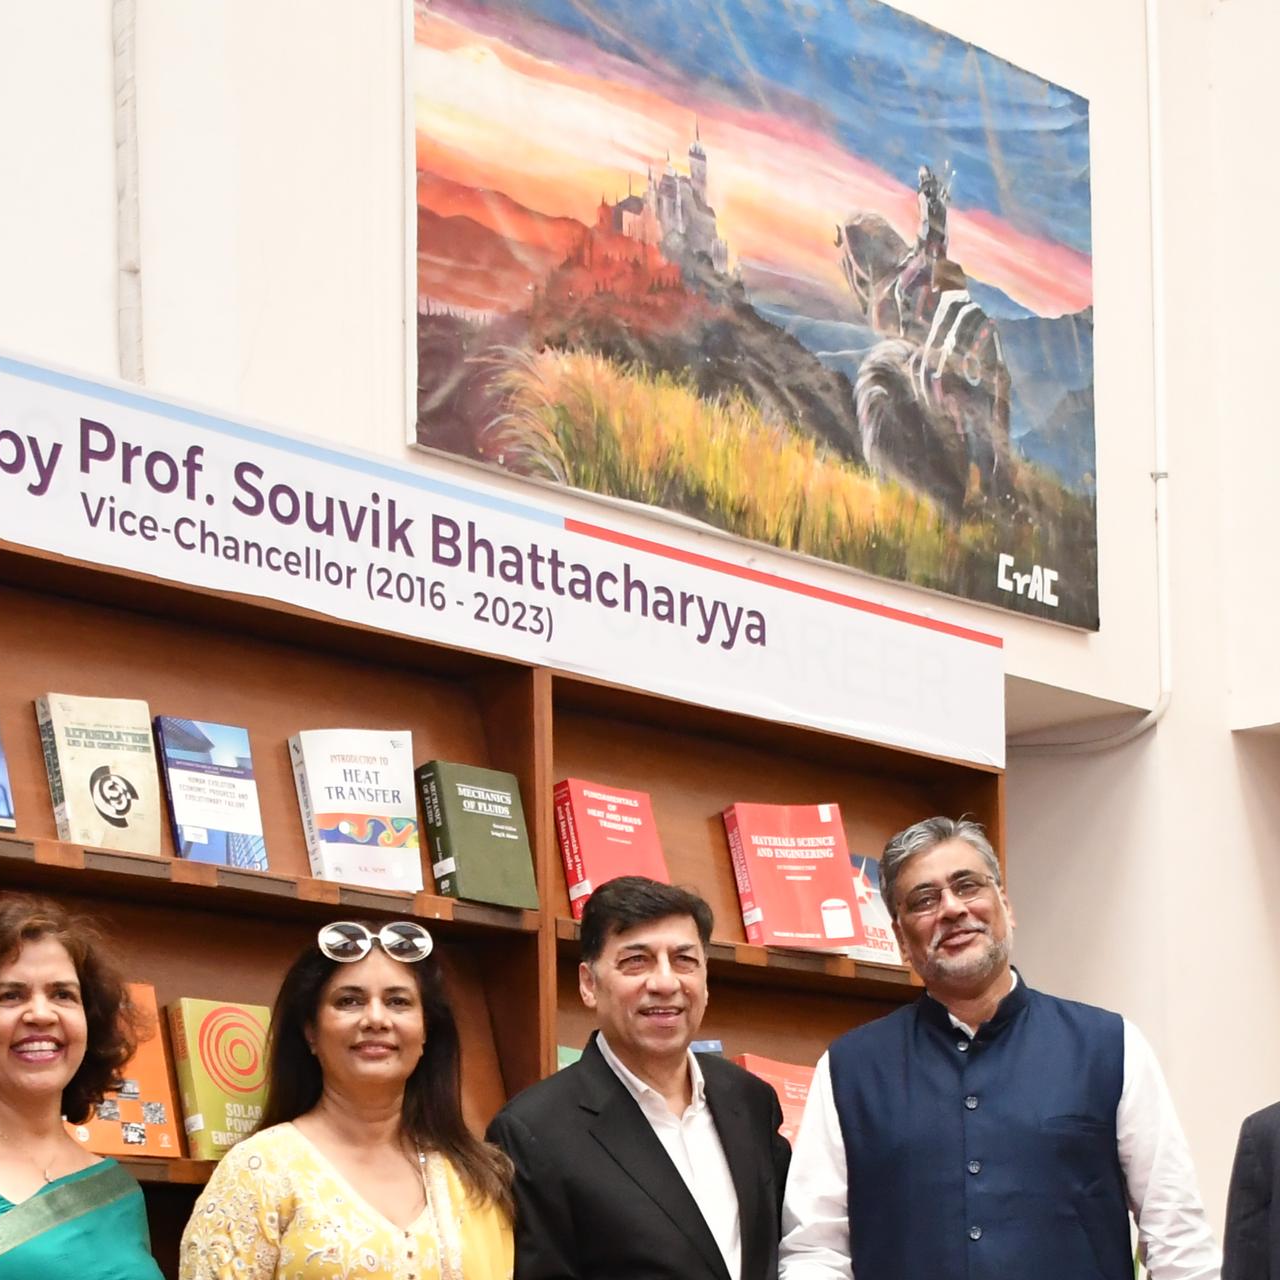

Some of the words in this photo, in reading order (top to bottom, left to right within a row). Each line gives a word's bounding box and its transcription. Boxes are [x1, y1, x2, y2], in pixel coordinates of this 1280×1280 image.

[79, 417, 213, 505] Prof.
[231, 460, 414, 558] Souvik
[432, 513, 767, 652] Bhattacharyya
[80, 492, 357, 590] Vice-Chancellor
[365, 564, 448, 616] (2016
[473, 591, 555, 643] 2023)
[64, 726, 150, 745] REFRIGERATION
[330, 754, 377, 766] INTRODUCTION
[379, 756, 388, 766] TO
[342, 768, 381, 786] HEAT
[324, 786, 402, 804] TRANSFER
[429, 780, 443, 827] MECHANICS
[457, 786, 512, 805] MECHANICS
[582, 789, 640, 808] FUNDAMENTALS
[462, 799, 477, 810] OF
[477, 802, 510, 816] FLUIDS
[587, 807, 605, 819] HEAT
[621, 815, 643, 826] MASS
[564, 801, 579, 855] Fundamentals
[598, 818, 635, 832] TRANSFER
[751, 835, 797, 847] MATERIALS
[797, 835, 835, 847] SCIENCE
[563, 839, 573, 871] Transfer
[756, 848, 774, 859] AND
[775, 848, 834, 859] ENGINEERING
[225, 1102, 263, 1118] SOLAR
